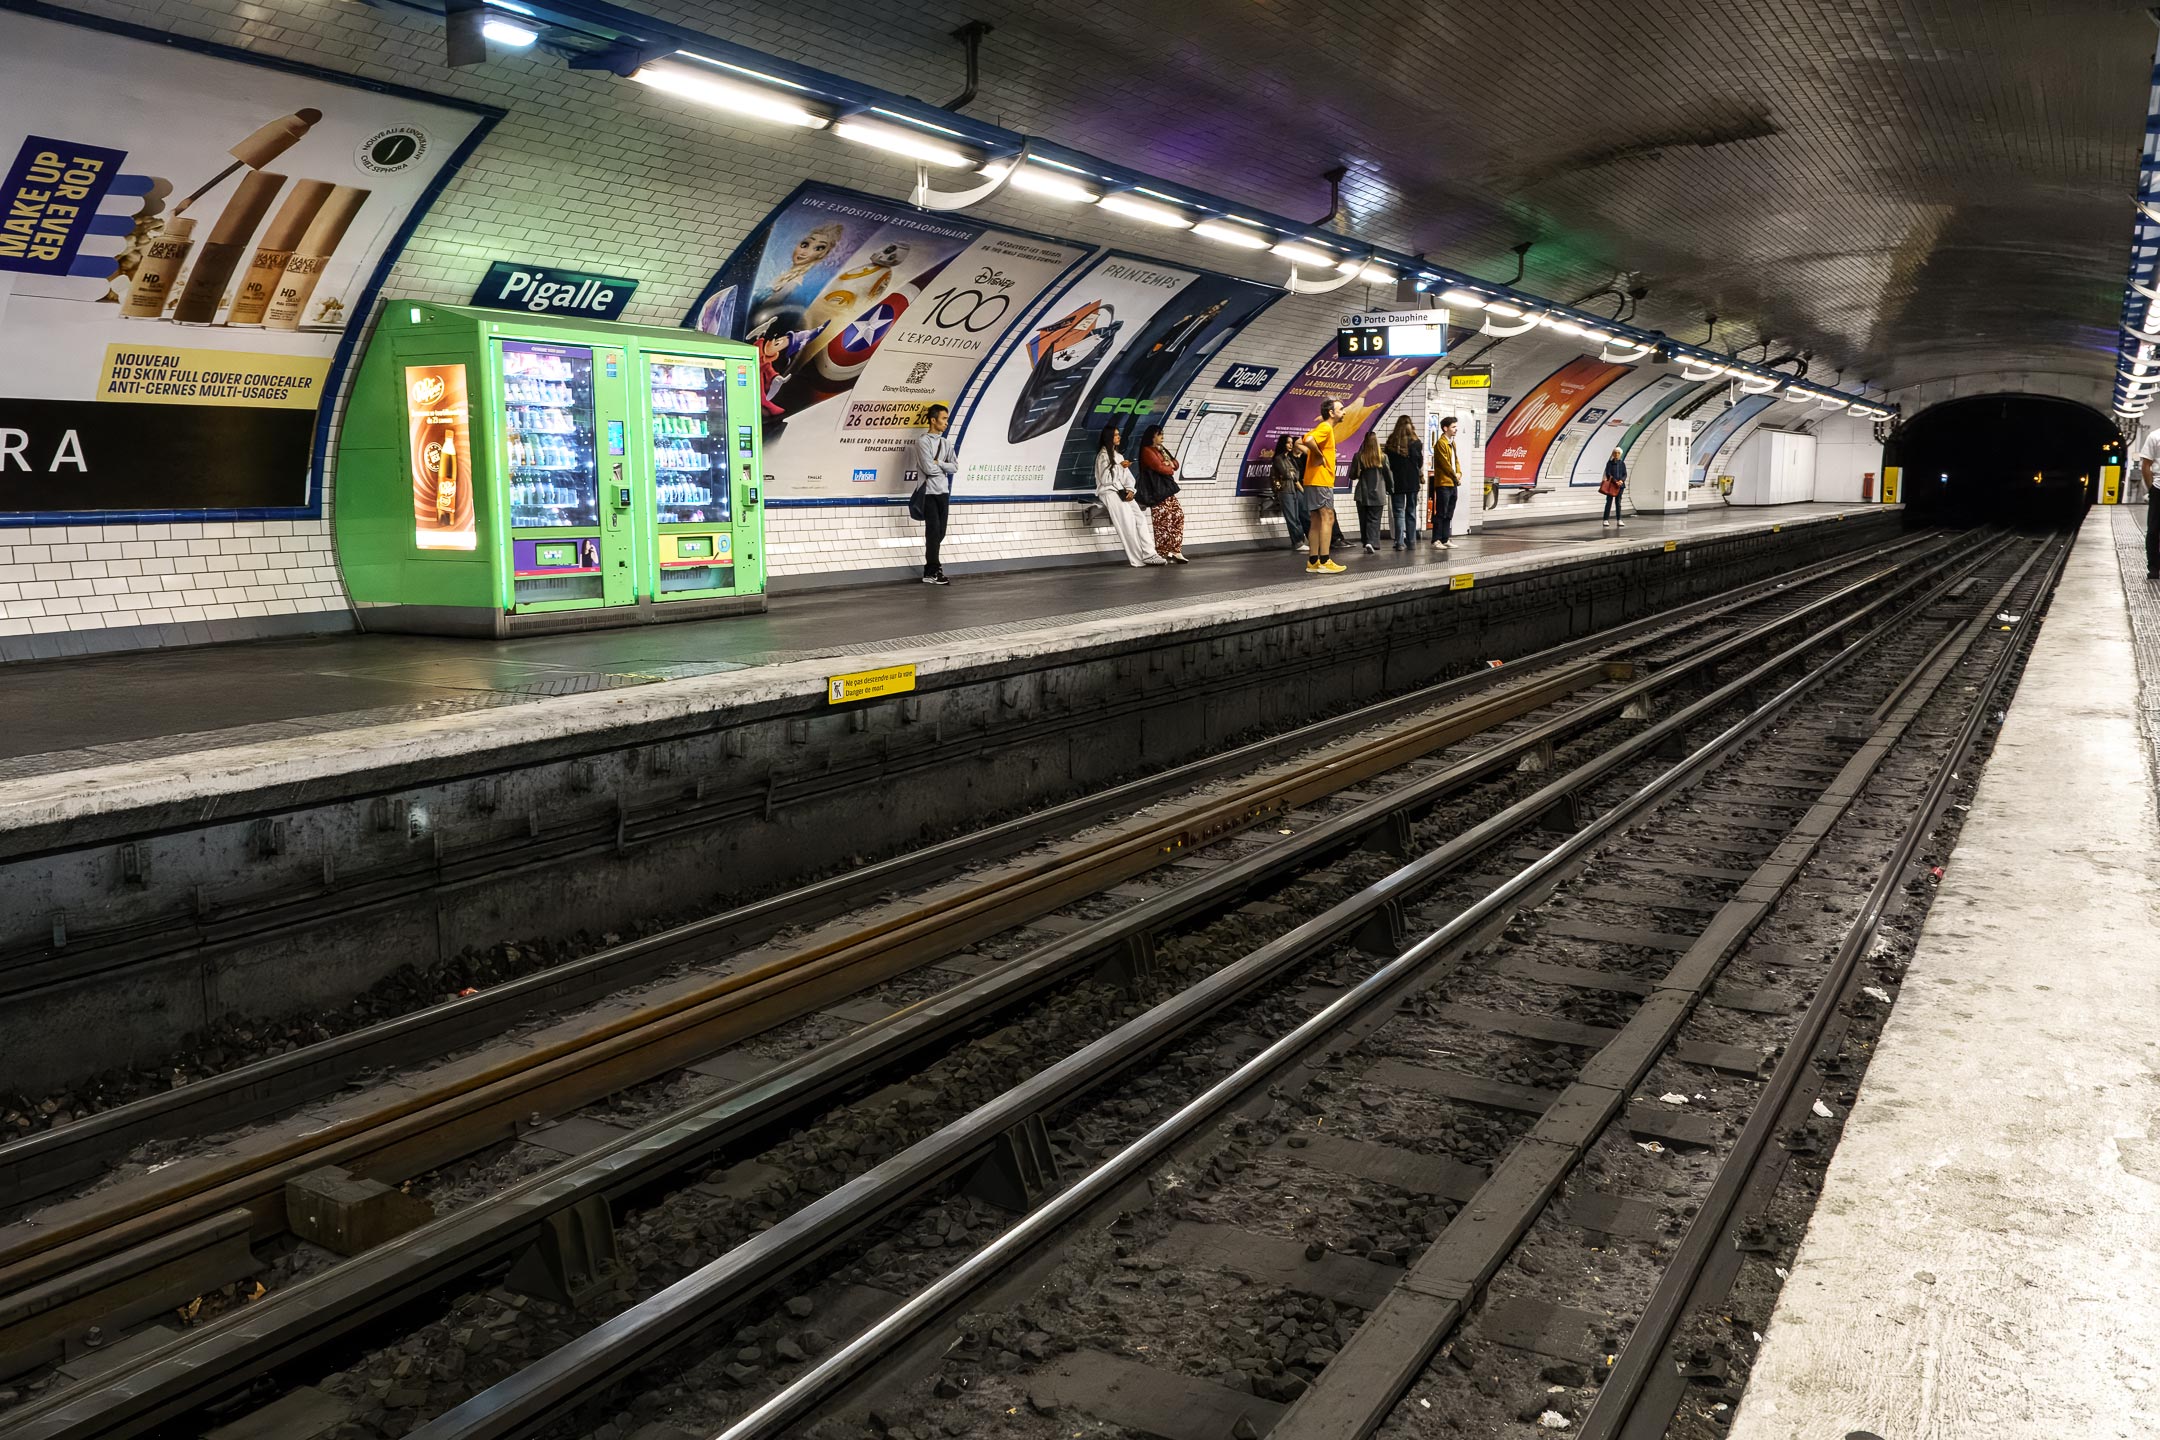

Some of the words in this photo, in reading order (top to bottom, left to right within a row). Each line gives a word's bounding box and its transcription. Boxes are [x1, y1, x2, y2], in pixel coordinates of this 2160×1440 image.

[54, 157, 104, 200] FOR
[0, 187, 52, 258] MAKE
[26, 151, 66, 184] UP
[802, 198, 826, 208] UNE
[827, 203, 890, 223] EXPOSITION
[890, 217, 973, 240] EXTRAORDINAIRE
[27, 203, 80, 260] EVER
[142, 273, 160, 283] HD
[1101, 264, 1181, 289] PRINTEMPS
[247, 282, 262, 292] HD
[280, 288, 296, 298] HD
[498, 271, 614, 312] Pigalle
[922, 287, 1010, 333] 100
[1364, 315, 1386, 324] Porte
[1388, 313, 1428, 325] Dauphine
[898, 332, 982, 350] L'EXPOSITION
[1348, 336, 1358, 352] 5
[1372, 336, 1383, 351] 9
[114, 353, 180, 368] NOUVEAU
[112, 366, 130, 380] HD
[133, 368, 171, 382] SKIN
[168, 370, 198, 383] FULL
[202, 372, 242, 385] COVER
[244, 374, 312, 388] CONCEALER
[1227, 367, 1268, 388] Pigalle
[1305, 360, 1352, 379] SHEN
[1344, 364, 1379, 382] YUN
[108, 380, 196, 396] ANTI-CERNES
[199, 385, 288, 400] MULTI-USAGES
[852, 404, 921, 412] PROLONGATIONS
[846, 414, 862, 427] 26
[865, 414, 910, 426] octobre
[854, 678, 863, 687] pas
[864, 674, 888, 684] descendre
[846, 688, 864, 697] Danger
